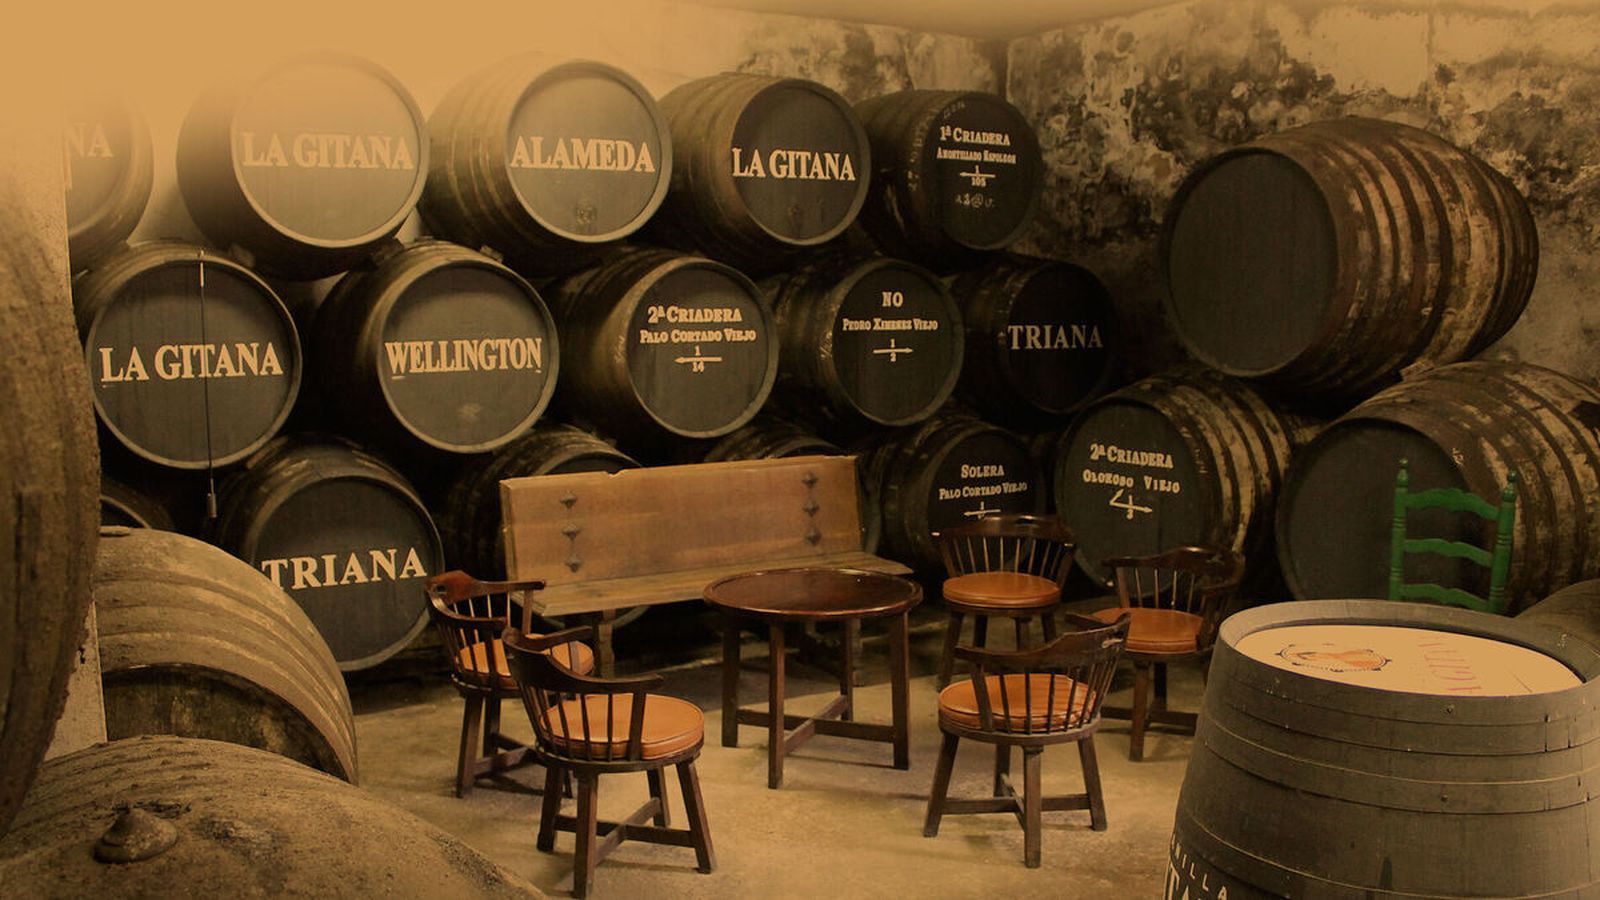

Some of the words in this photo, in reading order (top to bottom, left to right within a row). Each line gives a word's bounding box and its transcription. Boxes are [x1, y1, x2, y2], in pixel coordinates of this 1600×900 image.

[953, 126, 1011, 147] CRIADERA
[242, 131, 289, 168] LA
[293, 131, 414, 171] GITANA
[509, 135, 655, 173] ALAMEDA
[731, 147, 765, 178] LA
[768, 149, 856, 182] GITANA
[882, 291, 904, 308] NO
[665, 305, 743, 323] CRIADERA
[842, 318, 872, 332] PEDRO
[912, 318, 940, 332] VIEJO
[639, 329, 669, 344] PALO
[670, 329, 723, 344] CORTADO
[723, 328, 757, 342] VIEJO
[1007, 325, 1104, 350] TRIANA
[98, 346, 150, 384] LA
[154, 341, 284, 380] GITANA
[384, 337, 542, 374] WELLINGTON
[1106, 445, 1174, 469] CRIADERA
[960, 463, 1005, 479] SOLERA
[938, 487, 962, 501] PALO
[962, 485, 1002, 499] CORTADO
[1002, 481, 1029, 495] VIEJO
[1143, 474, 1181, 494] VIEJO
[260, 547, 428, 590] TRIANA
